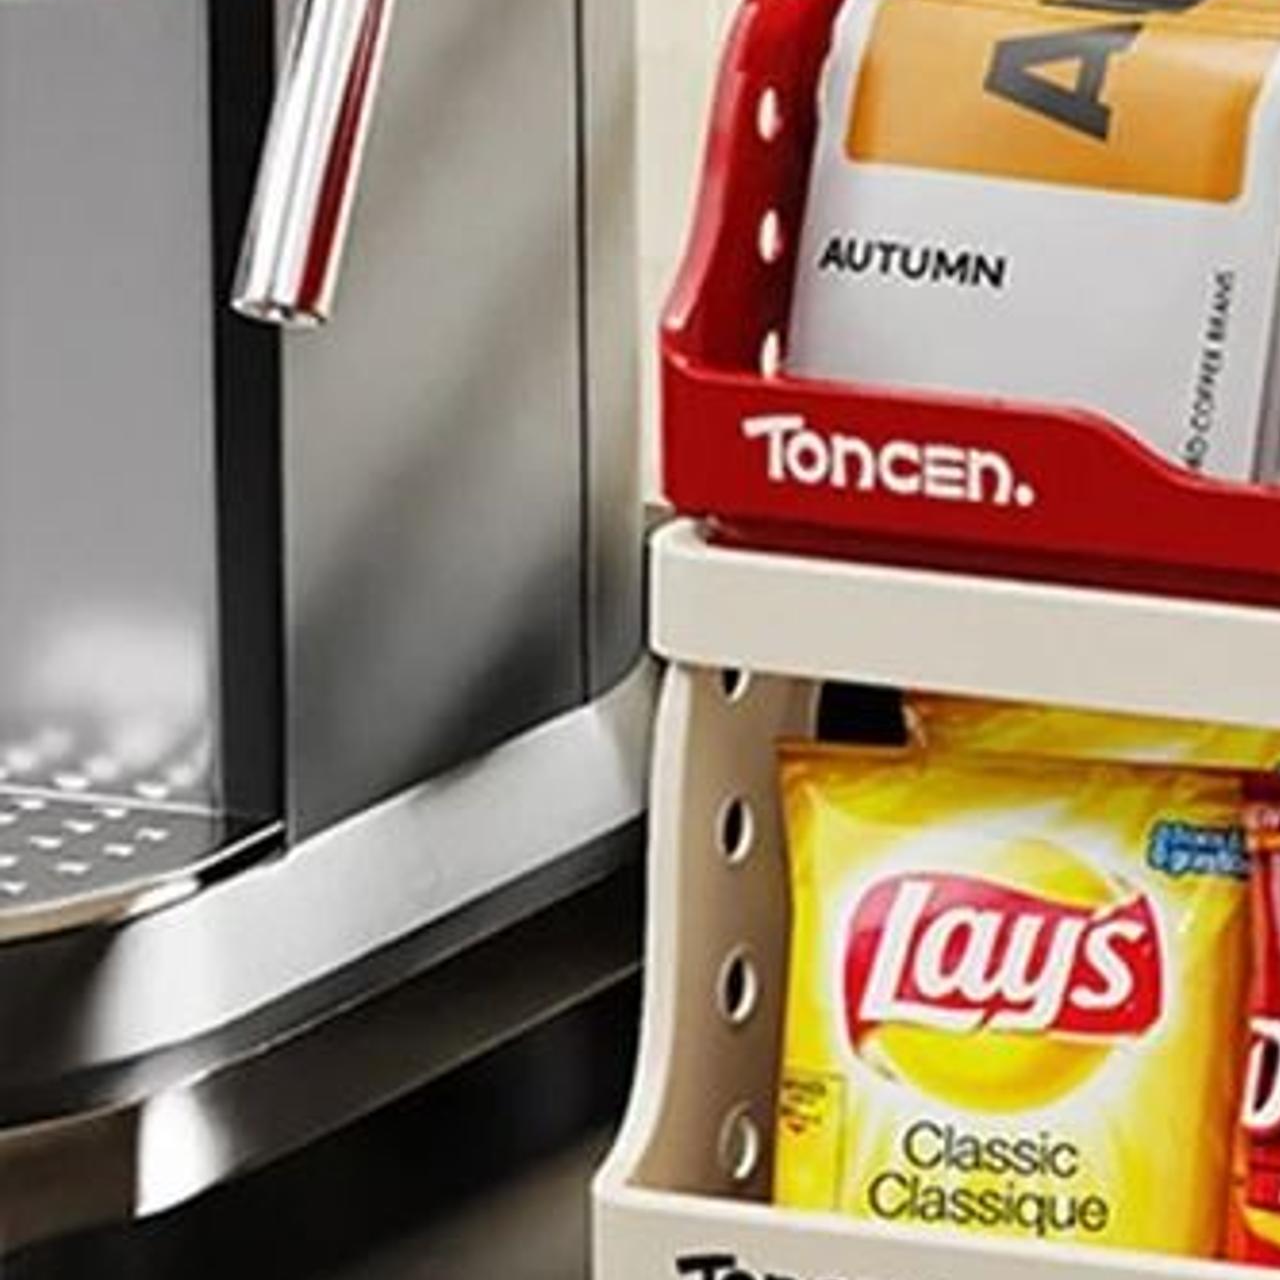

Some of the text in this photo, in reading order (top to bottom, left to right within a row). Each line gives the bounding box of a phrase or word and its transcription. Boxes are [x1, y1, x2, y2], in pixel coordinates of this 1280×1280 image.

[818, 235, 1007, 290] AUTUMN
[858, 880, 1145, 1032] Lay's
[903, 1120, 1080, 1178] Classic
[867, 1171, 1109, 1237] Classique
